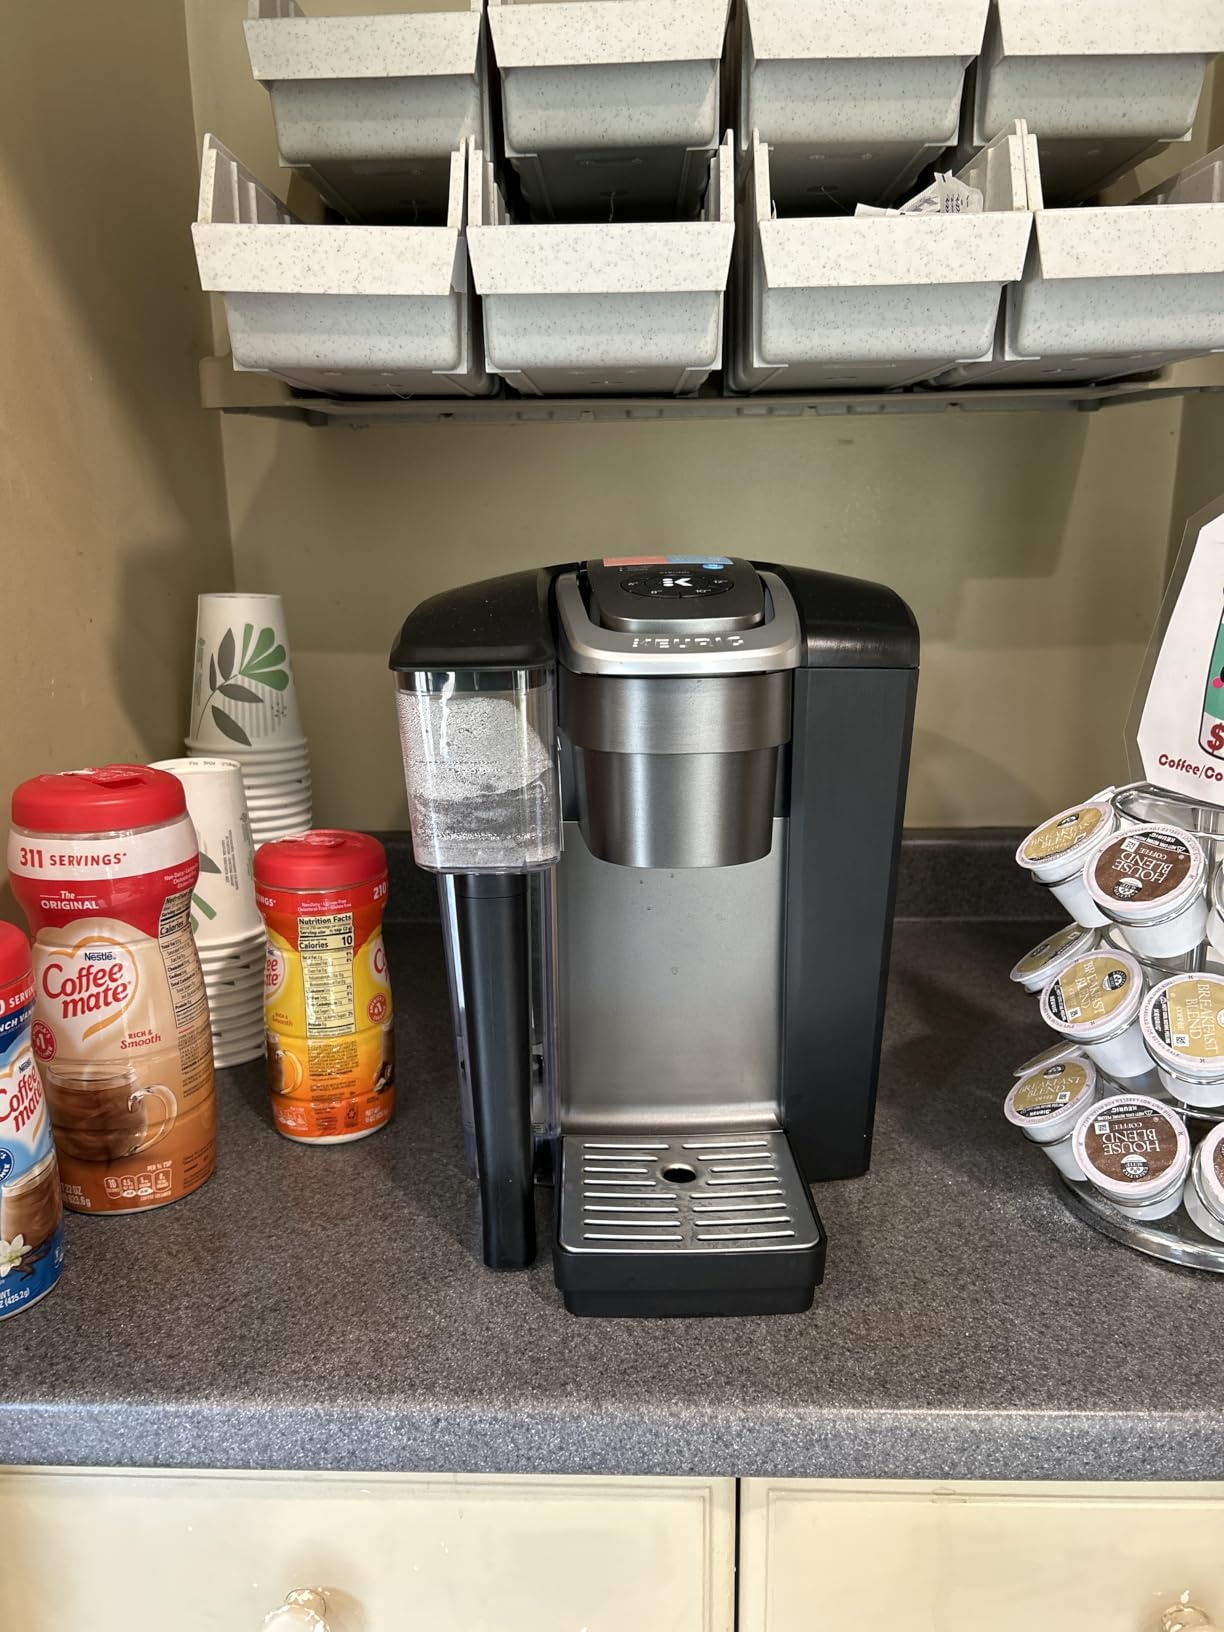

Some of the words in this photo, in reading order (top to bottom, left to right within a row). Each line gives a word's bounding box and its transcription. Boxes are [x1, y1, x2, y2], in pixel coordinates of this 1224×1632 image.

[20, 848, 44, 868] 311
[1120, 851, 1174, 874] BLEND
[1112, 859, 1167, 883] HOUSE
[61, 891, 75, 899] The
[41, 900, 99, 910] ORIGINAL
[299, 917, 331, 925] Nutrition
[342, 935, 353, 945] 10
[42, 963, 124, 999] Coffee
[62, 982, 129, 1019] mate
[1185, 998, 1202, 1040] BLEND
[1197, 984, 1218, 1055] BREAKFAST
[120, 1035, 161, 1049] Smooth
[128, 1031, 146, 1039] RICH
[1102, 1129, 1157, 1144] BLEND
[1102, 1141, 1160, 1155] HOUSE
